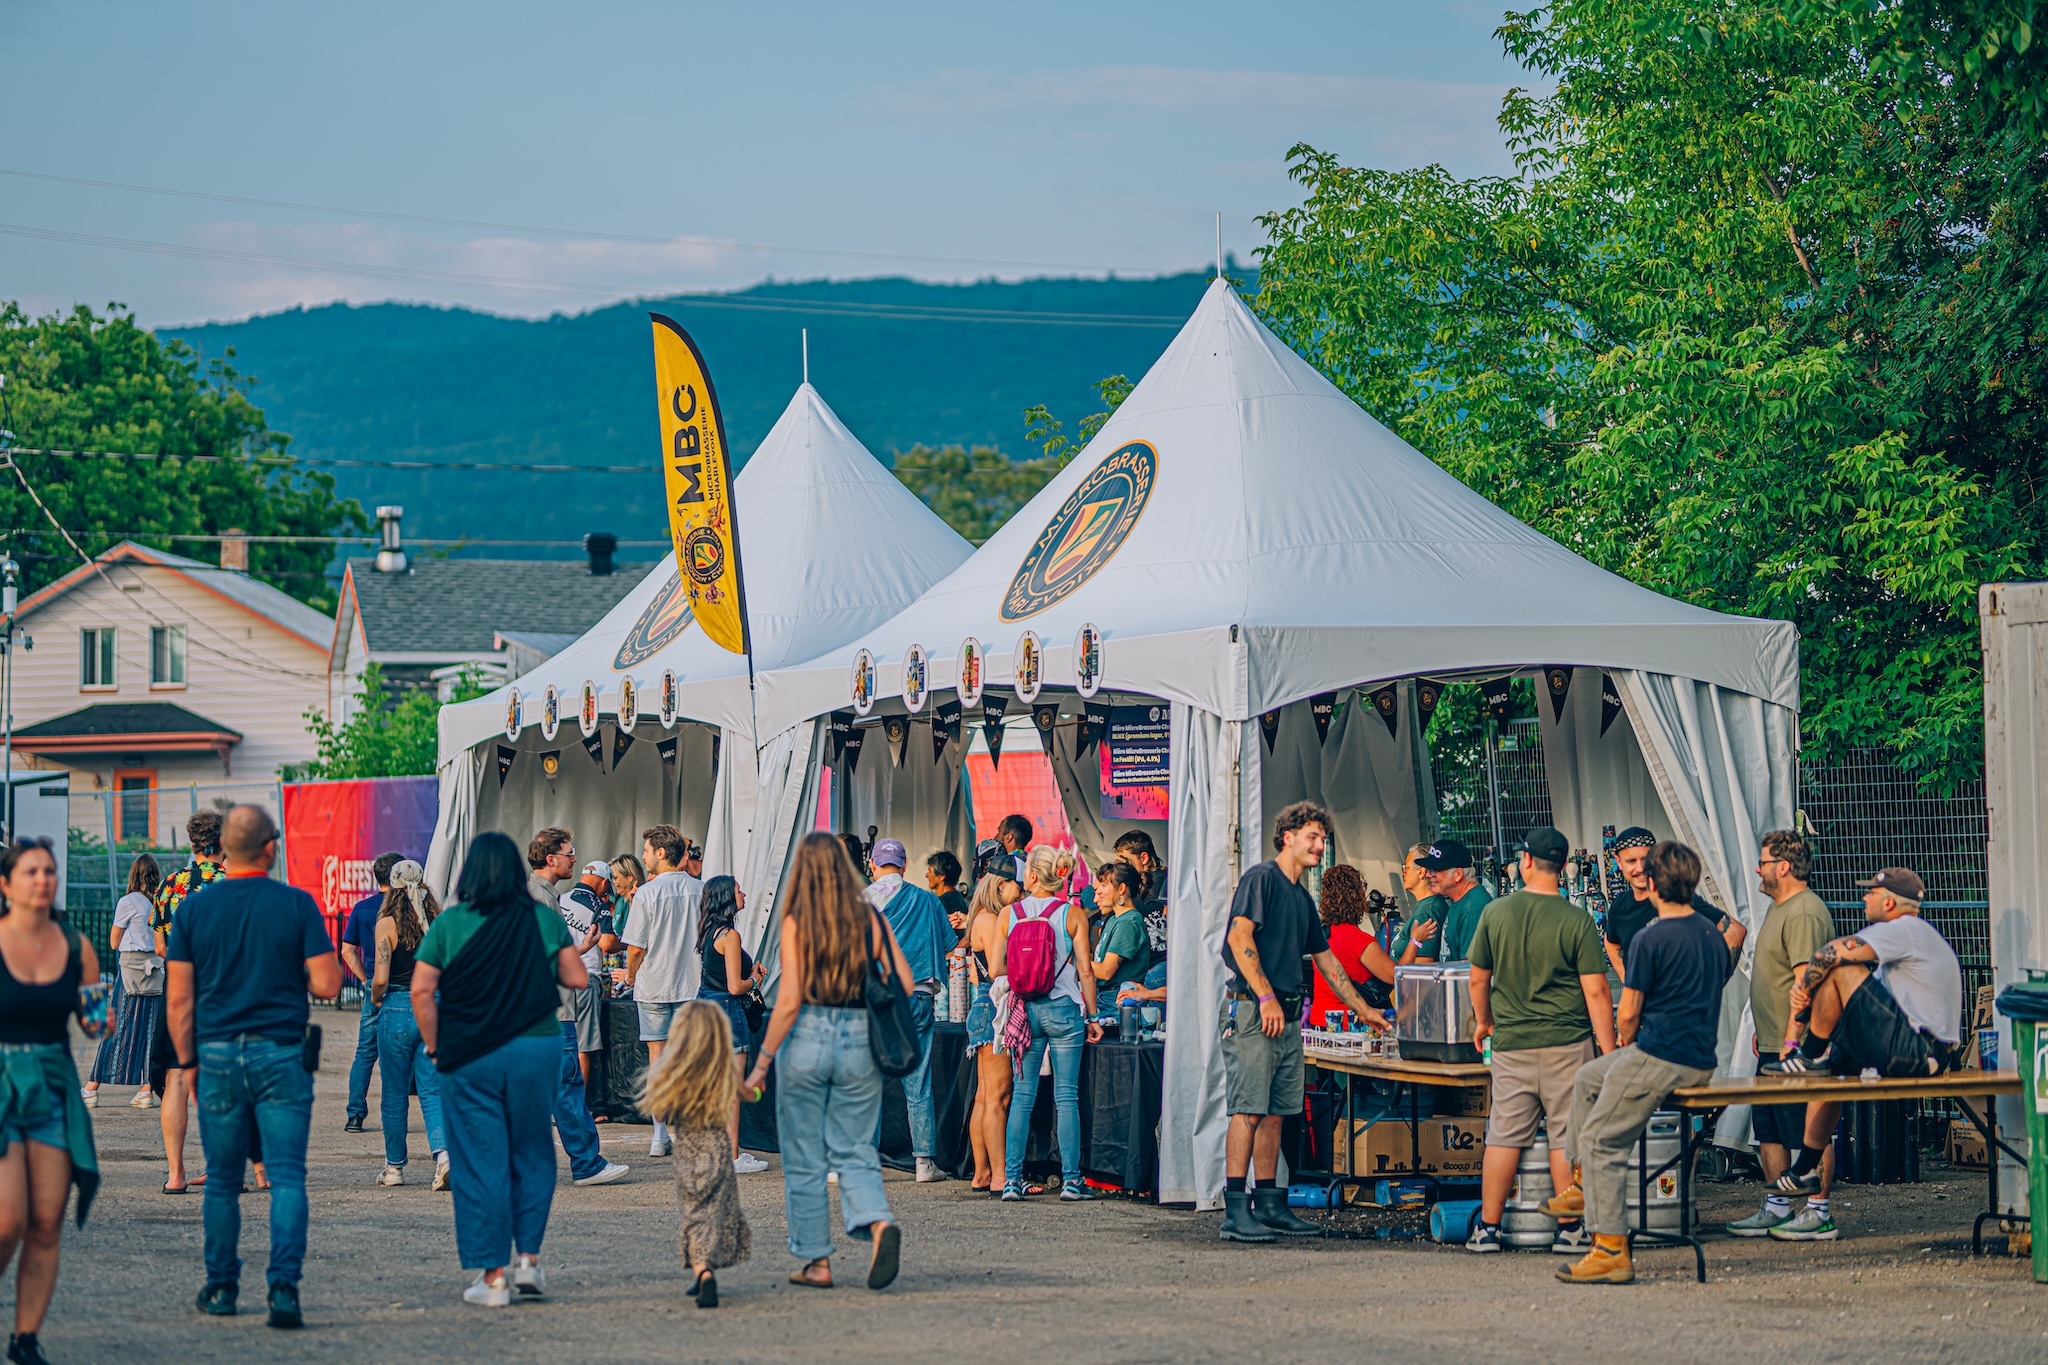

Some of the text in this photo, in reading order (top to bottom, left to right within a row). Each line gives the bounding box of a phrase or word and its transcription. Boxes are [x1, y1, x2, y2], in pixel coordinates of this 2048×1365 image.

[673, 383, 705, 504] MBC
[701, 406, 715, 501] MICROBRASSERIE
[709, 430, 721, 500] CHARLEVOIX
[1038, 452, 1150, 548] MICROBRASSERIE
[1008, 556, 1102, 614] CHARLEVOIX
[1488, 692, 1508, 706] MBC
[1602, 691, 1621, 707] MBC
[985, 706, 1003, 717] MBC
[1313, 704, 1332, 714] MBC
[944, 712, 960, 724] MBC
[1087, 714, 1105, 724] MBC
[833, 723, 849, 732] MBC
[934, 730, 948, 739] MBC
[845, 740, 861, 748] MBC
[1443, 1124, 1486, 1150] Re-
